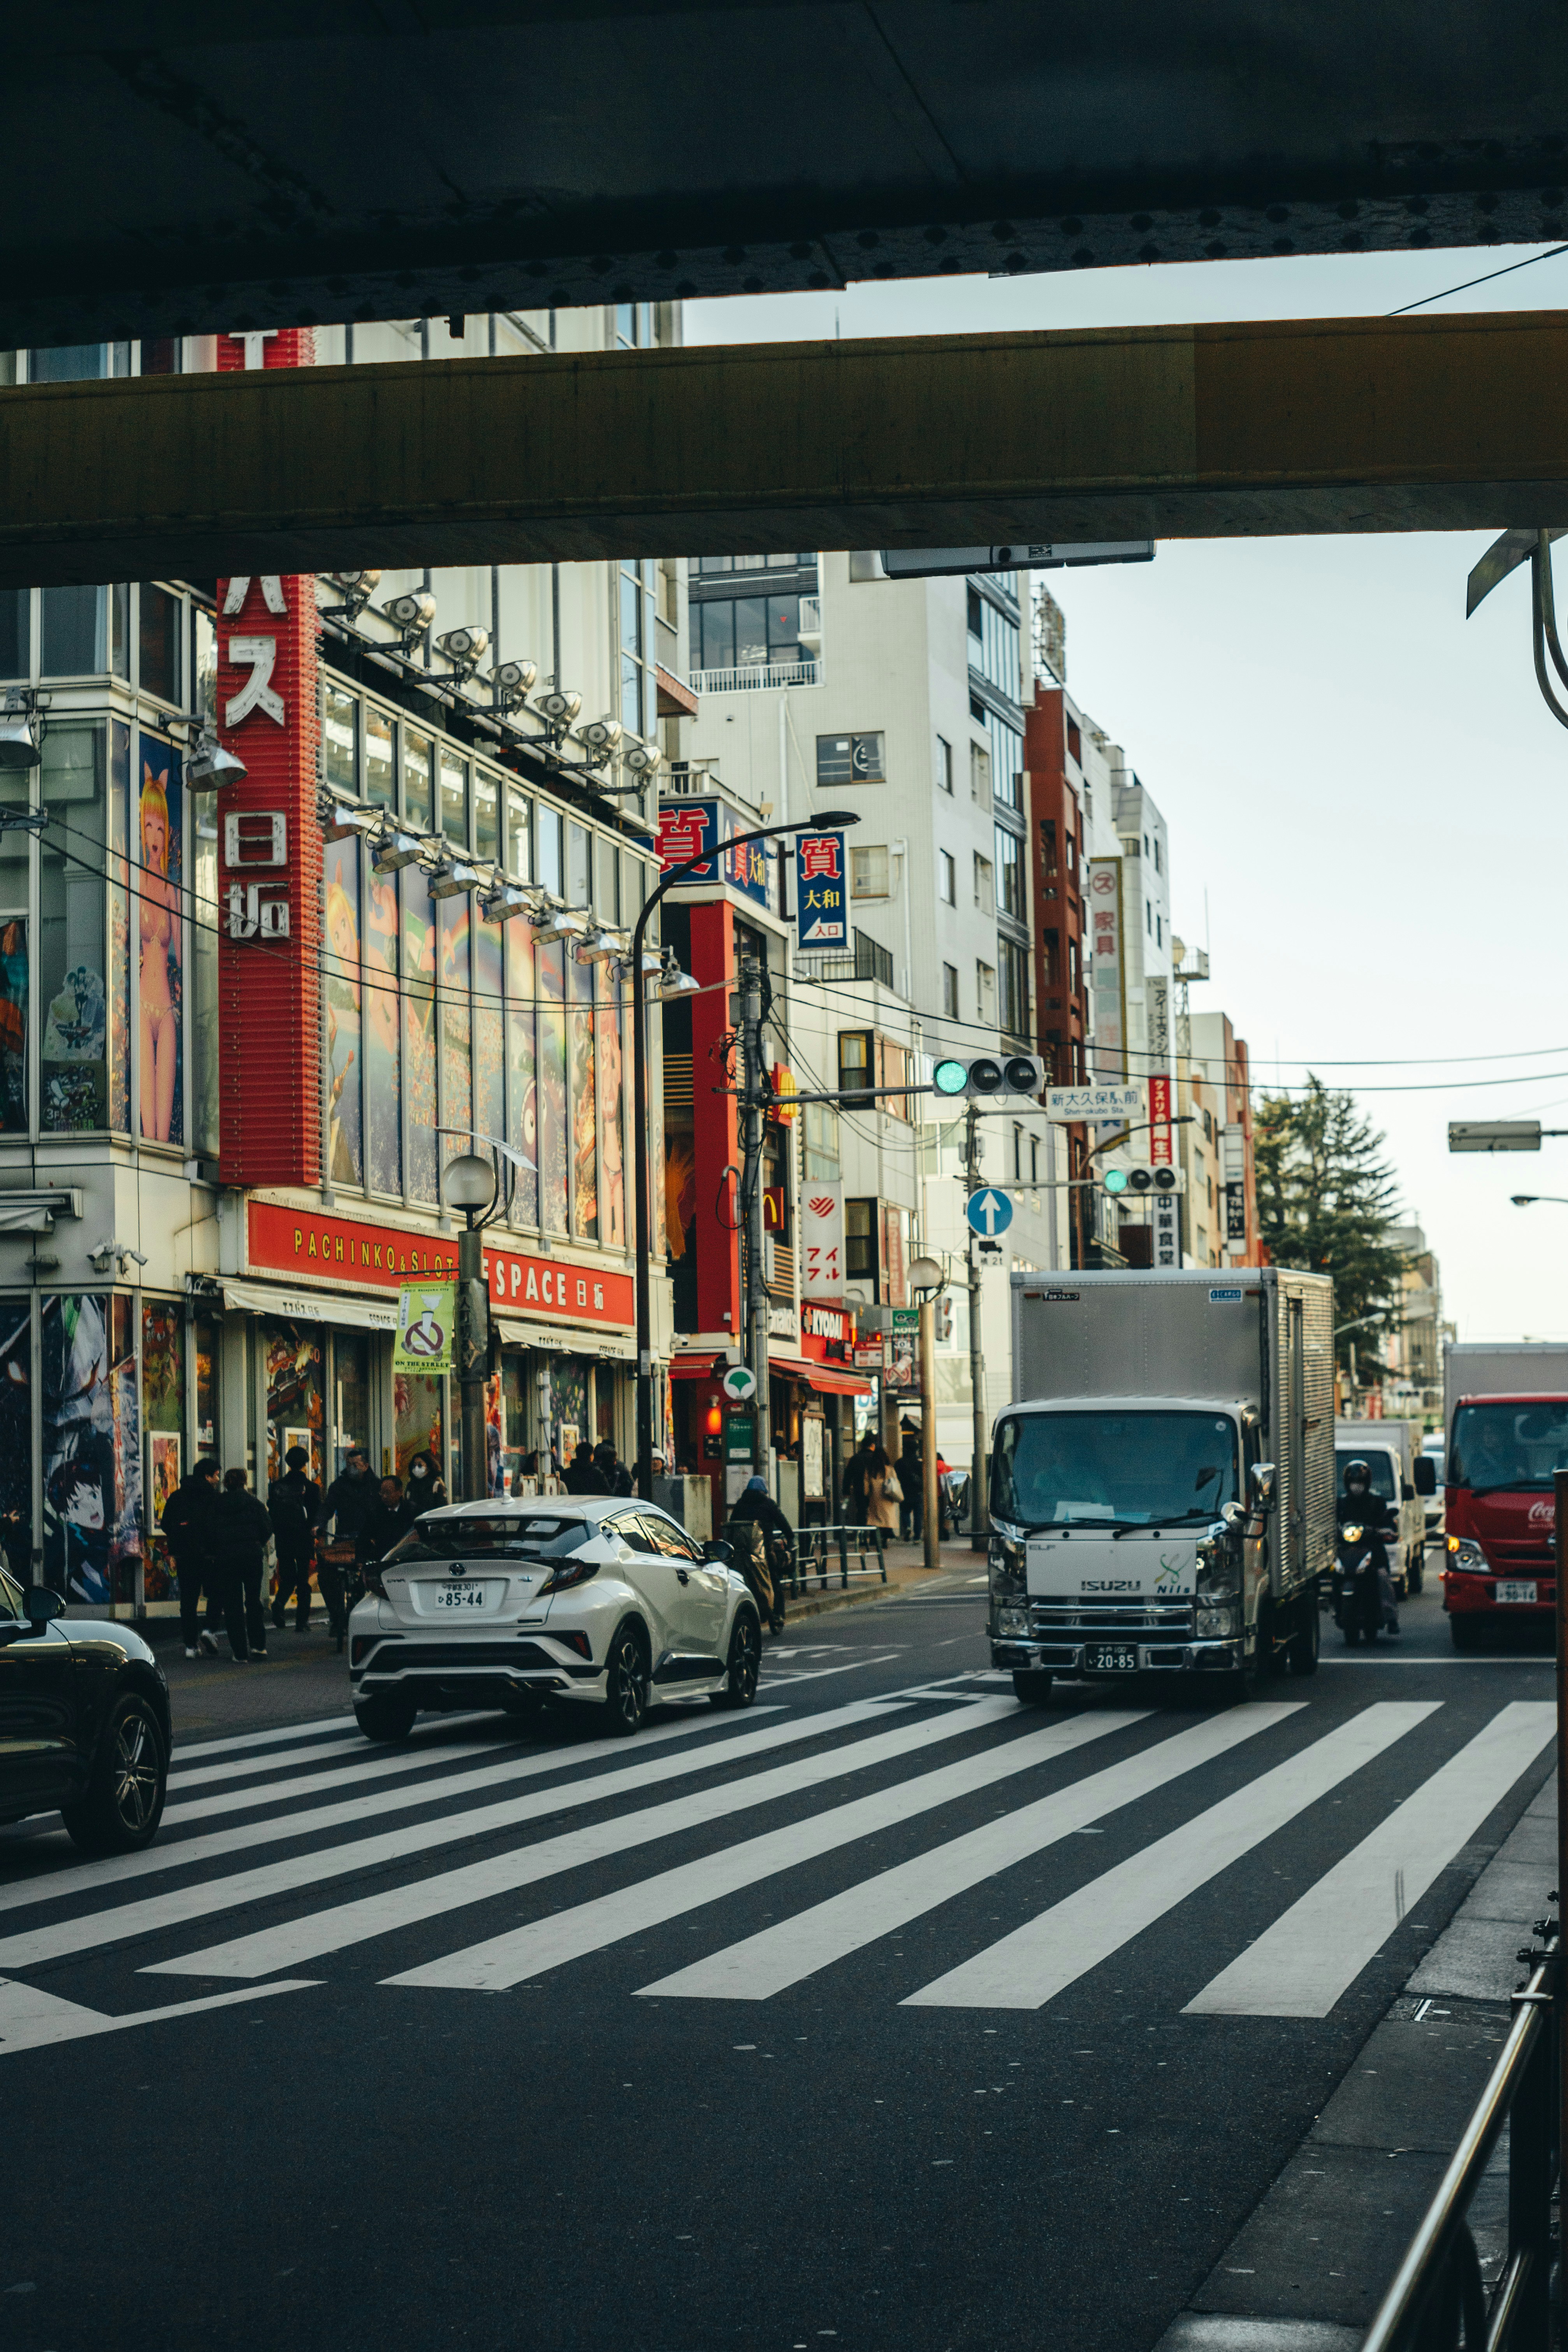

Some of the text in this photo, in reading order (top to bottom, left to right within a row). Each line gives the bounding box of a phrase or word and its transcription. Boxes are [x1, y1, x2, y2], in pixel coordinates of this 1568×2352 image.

[653, 808, 712, 874] 質
[749, 847, 765, 886] 大和
[800, 837, 842, 881] 質
[803, 889, 840, 910] 大和
[815, 925, 838, 937] 入口
[1094, 911, 1116, 955] 家具
[1051, 1091, 1137, 1106] 新大久保駅前
[1158, 1195, 1174, 1265] 中華食堂
[807, 1247, 838, 1262] アイ
[807, 1267, 840, 1281] フル
[577, 1279, 604, 1311] 日拓
[812, 1309, 843, 1340] KYODAI
[1081, 1580, 1141, 1591] ISUZU
[1157, 1586, 1190, 1594] Nils
[446, 1592, 482, 1605] 85-44
[1097, 1654, 1134, 1668] 20-85
